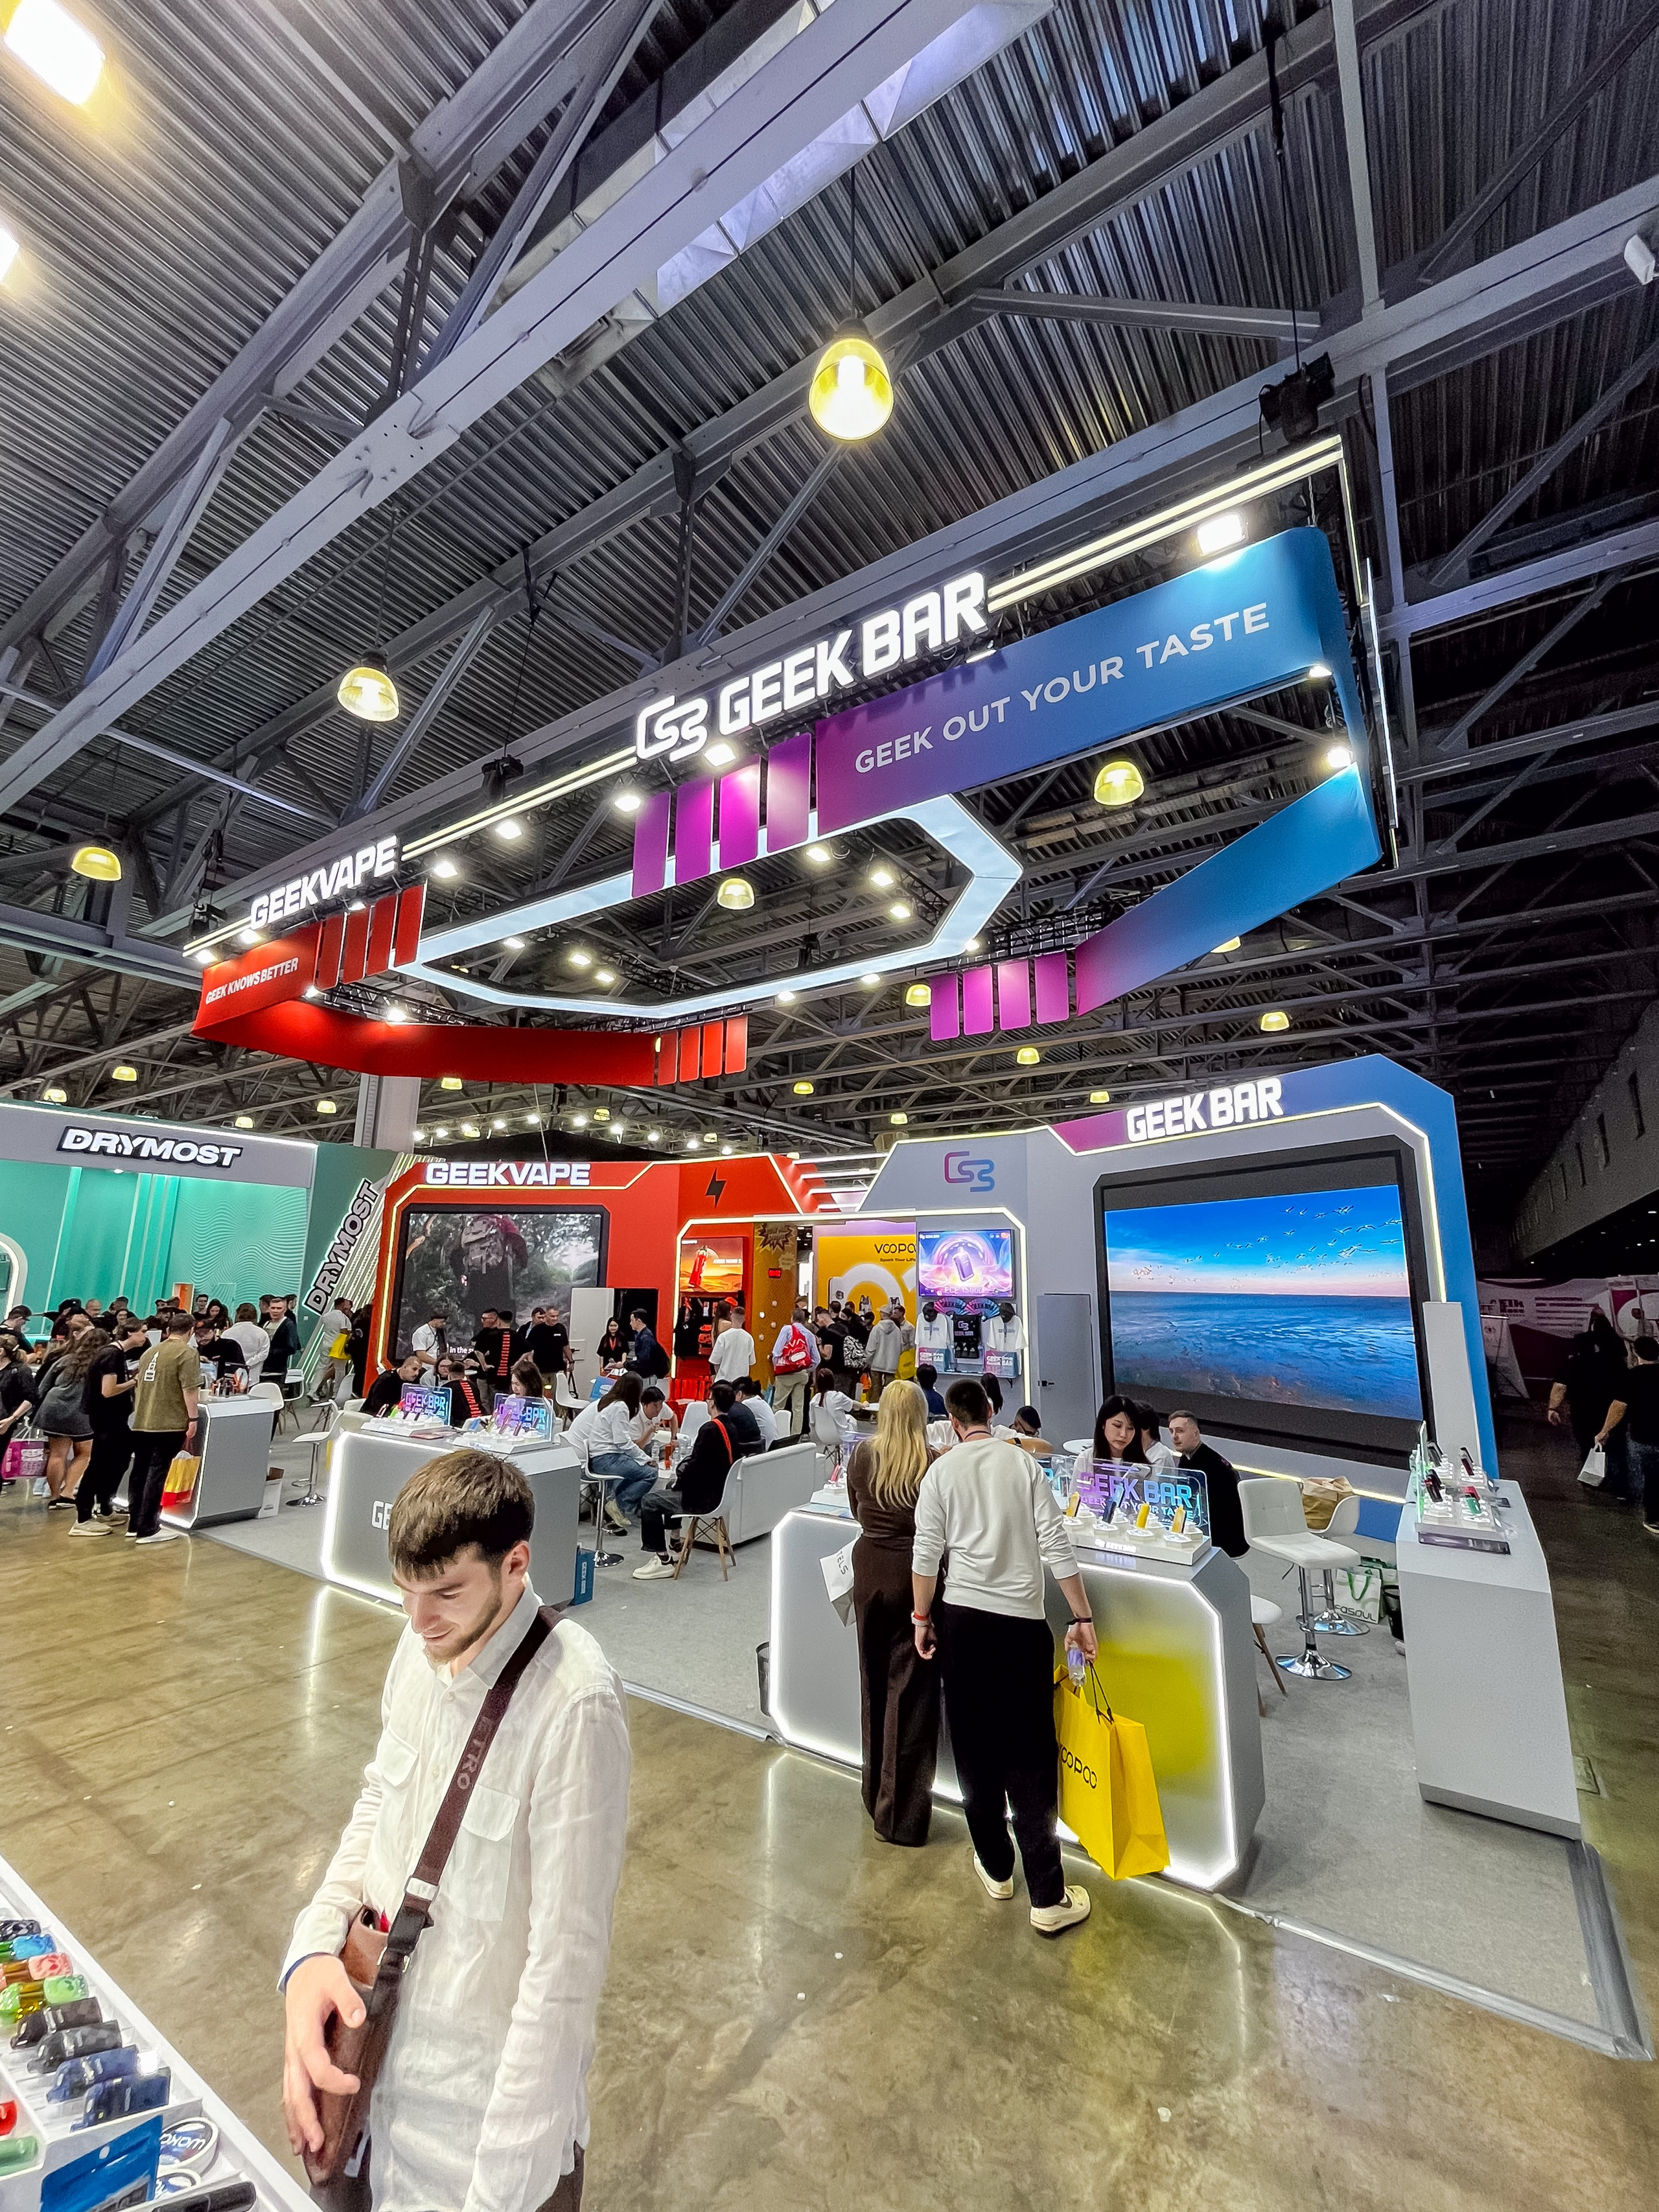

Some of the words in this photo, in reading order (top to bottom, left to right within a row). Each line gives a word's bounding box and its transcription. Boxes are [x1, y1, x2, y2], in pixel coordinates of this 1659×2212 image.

[718, 629, 855, 736] GEEK
[862, 572, 988, 679] BAR
[855, 726, 934, 774] GEEK
[942, 695, 1012, 742] OUT
[1021, 655, 1125, 712] YOUR
[1136, 601, 1270, 669] TASTE
[249, 834, 398, 931] GEEKVAPE
[205, 983, 228, 1005] GEEK
[227, 971, 261, 995] KNOWS
[259, 957, 299, 983] BETTER
[1126, 1093, 1207, 1143] GEEK
[1209, 1077, 1284, 1127] BAR
[60, 1128, 242, 1167] DRYMOST
[425, 1162, 591, 1186] GEEKVAPE
[305, 1180, 378, 1313] DRYMOST
[874, 1243, 916, 1254] VOOPO
[428, 1395, 446, 1410] BAR
[1143, 1479, 1193, 1509] BAR
[1060, 1745, 1098, 1789] OOPOO
